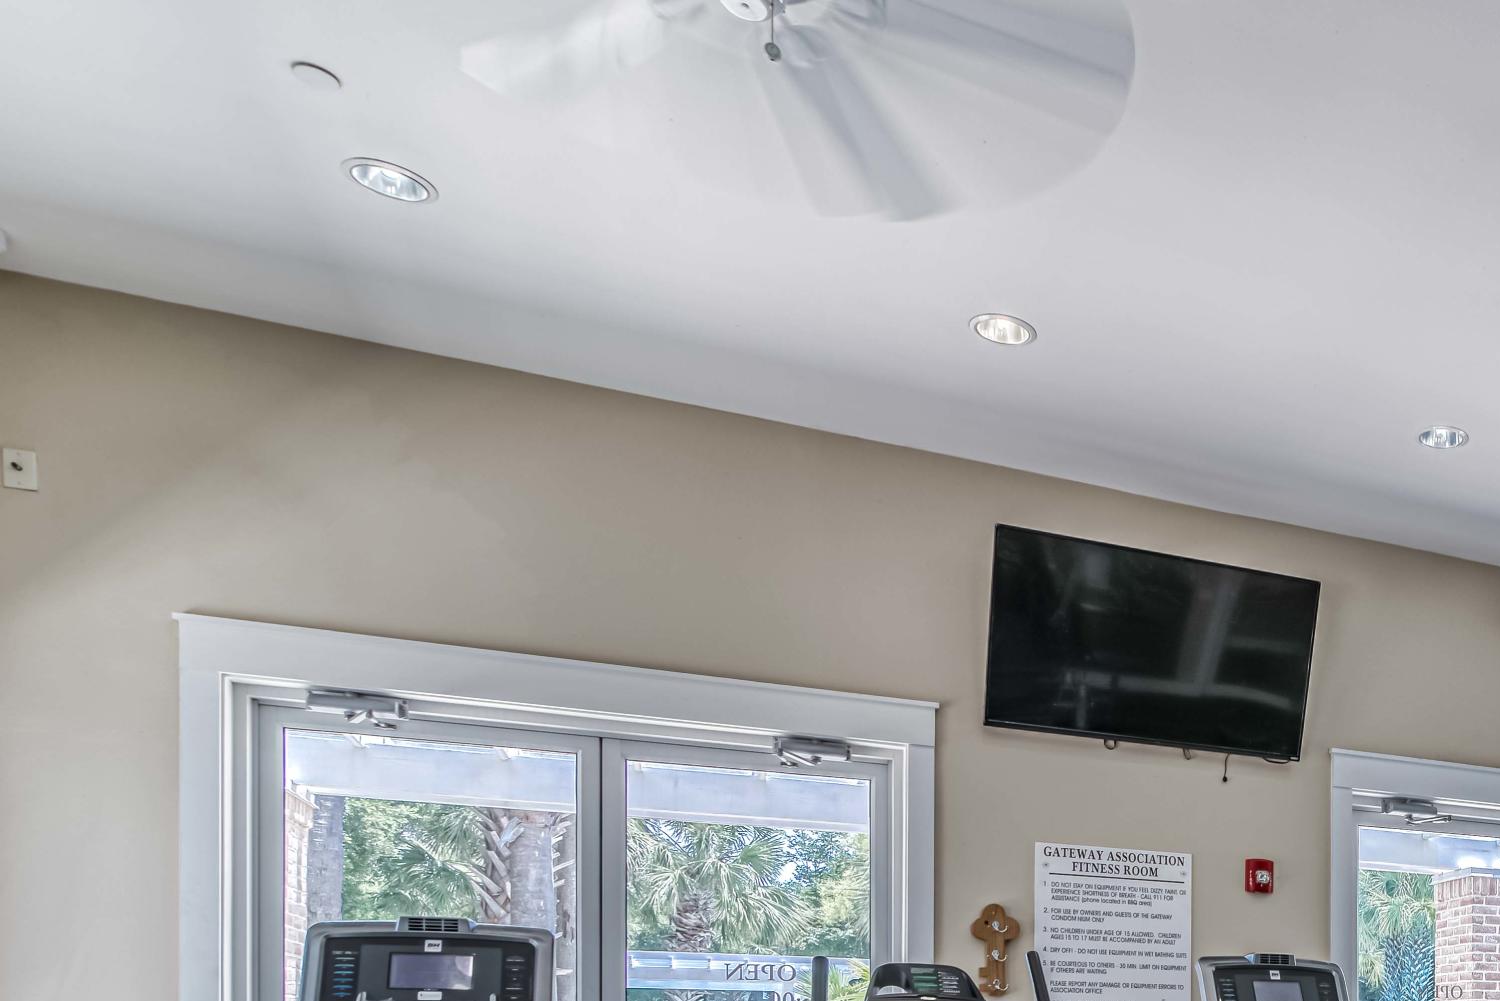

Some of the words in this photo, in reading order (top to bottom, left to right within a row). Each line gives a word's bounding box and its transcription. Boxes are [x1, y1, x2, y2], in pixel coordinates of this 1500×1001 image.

[1043, 845, 1103, 860] GATEWAY
[1106, 850, 1184, 866] ASSOCIATION
[1071, 860, 1120, 874] FITNESS
[1123, 864, 1158, 877] ROOM
[1050, 914, 1090, 922] CONDOMNIUM
